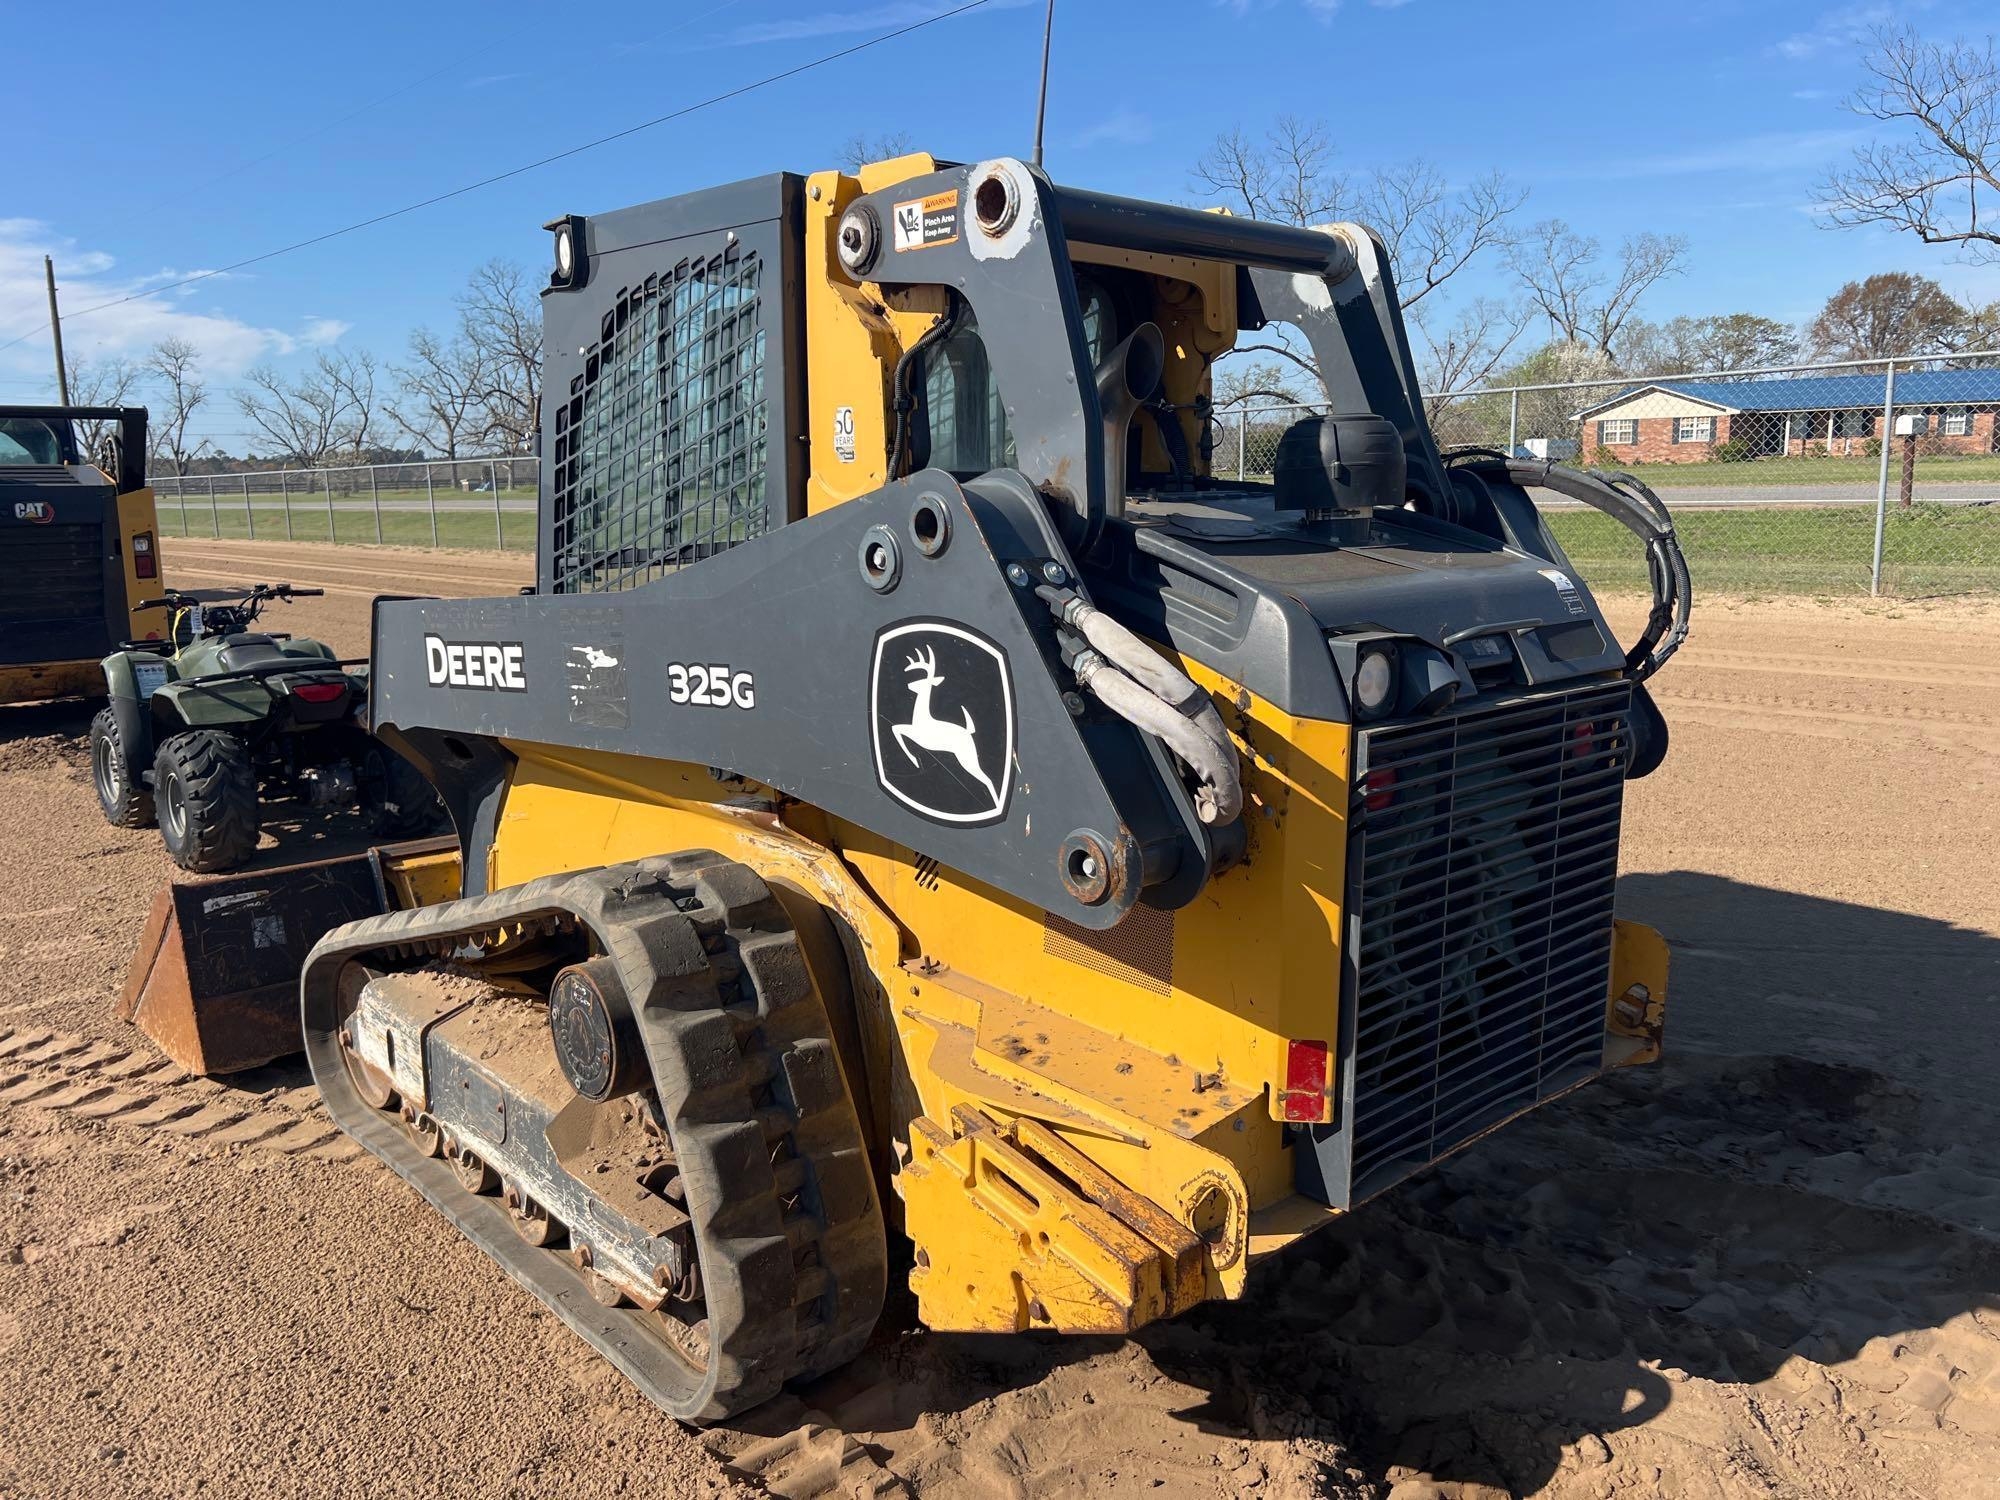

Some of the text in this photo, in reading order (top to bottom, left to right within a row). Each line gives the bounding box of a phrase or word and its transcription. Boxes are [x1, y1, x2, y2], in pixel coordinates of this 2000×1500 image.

[929, 194, 955, 207] WARNING
[924, 214, 955, 227] Pinch Area
[938, 226, 951, 234] Away
[14, 502, 44, 519] CAT
[425, 636, 526, 689] DEERE
[668, 664, 755, 709] 325G
